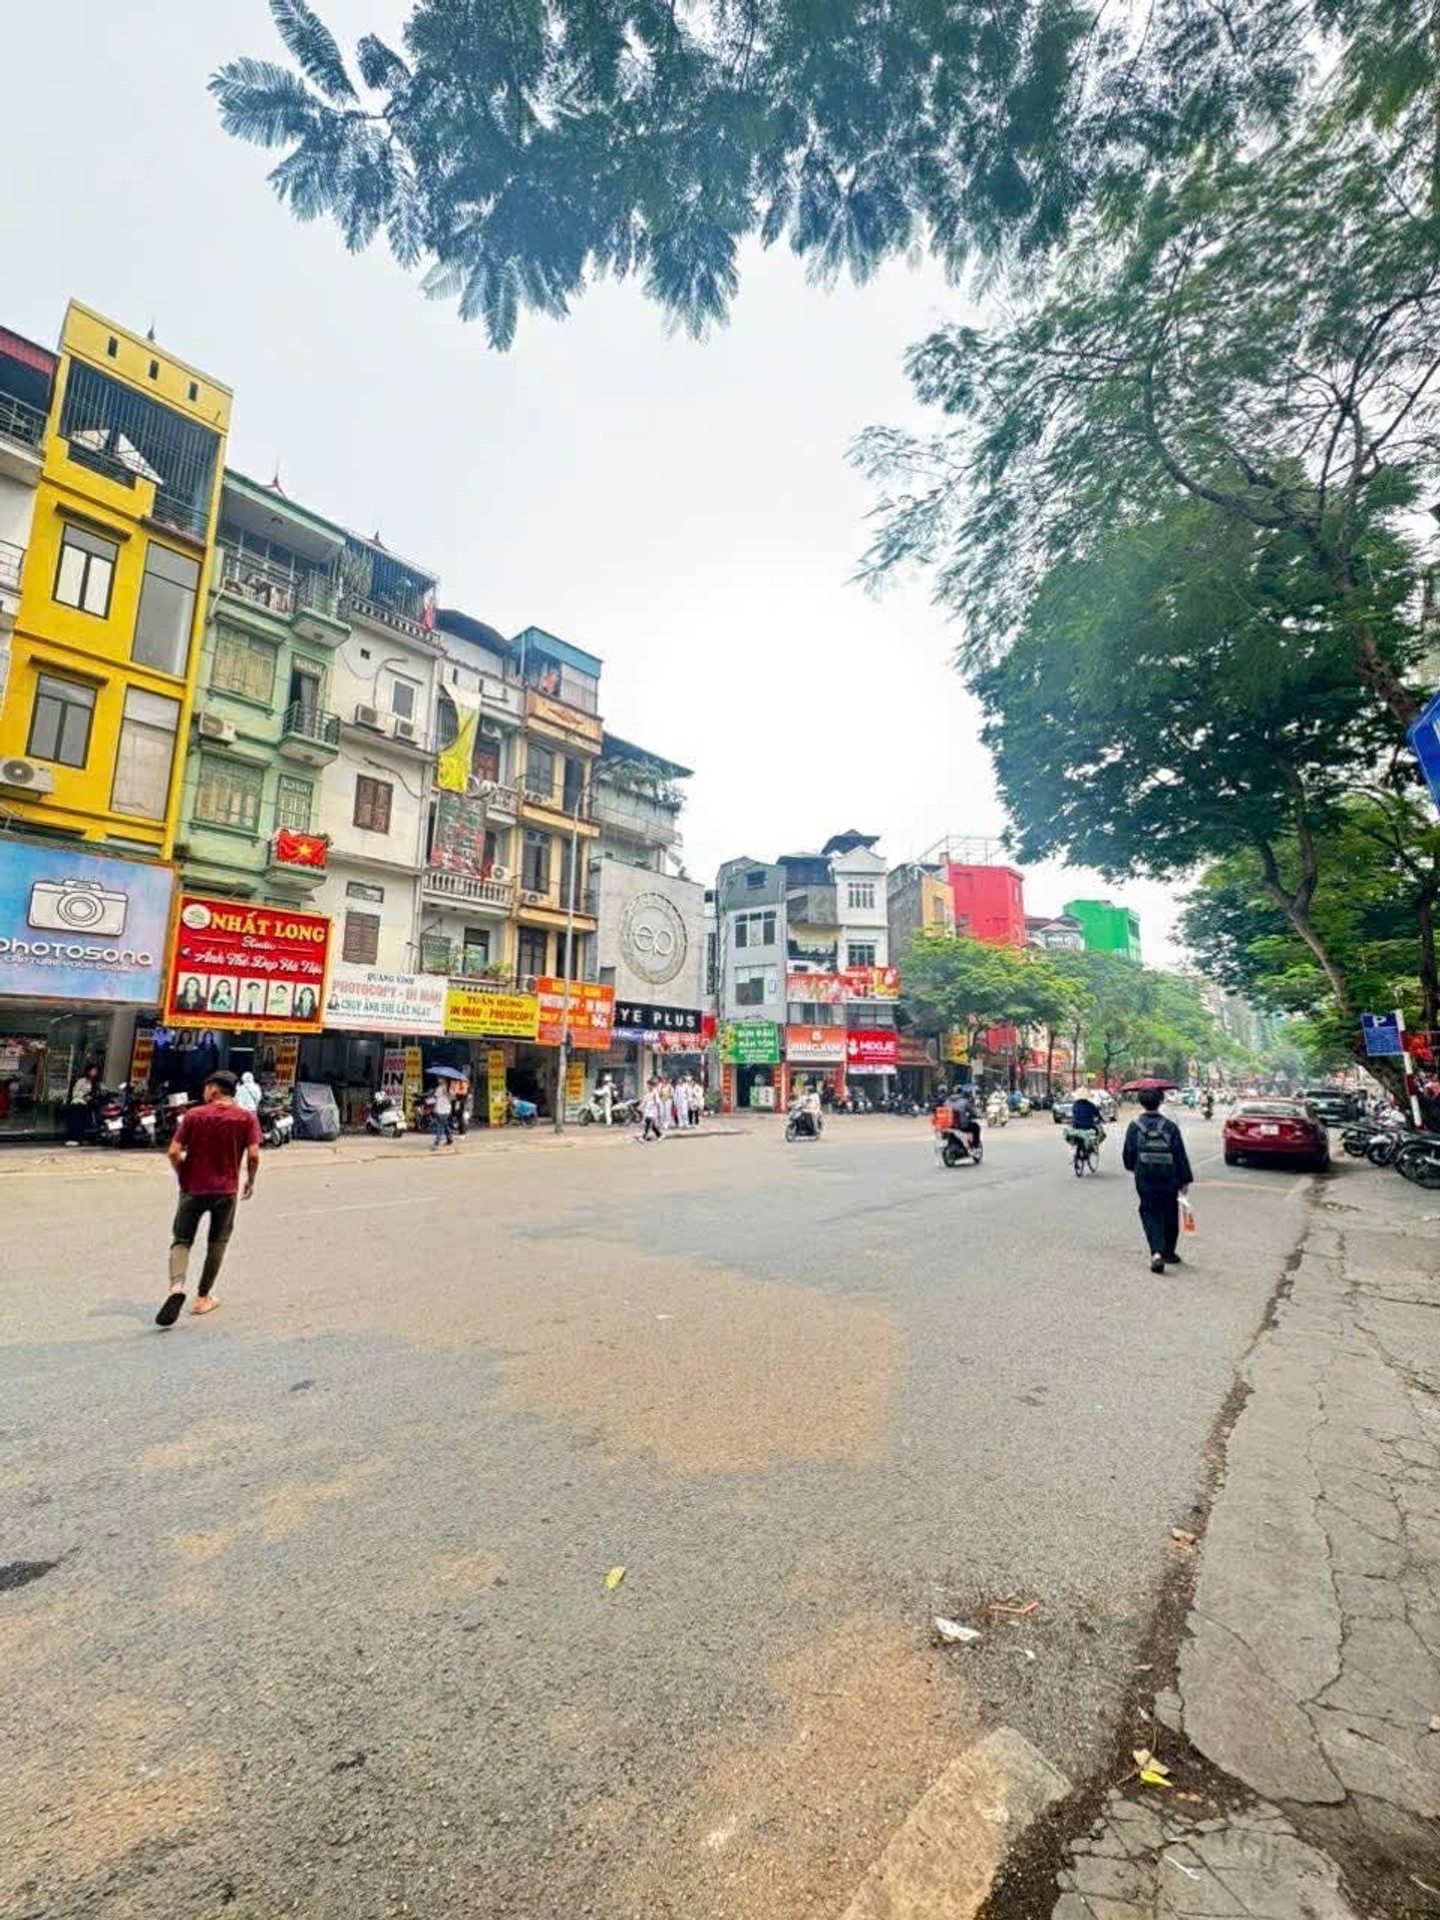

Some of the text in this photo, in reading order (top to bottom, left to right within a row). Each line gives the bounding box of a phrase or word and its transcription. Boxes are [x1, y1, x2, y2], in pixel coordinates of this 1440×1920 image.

[210, 911, 325, 943] NHẤT LONG
[332, 980, 396, 999] PHOTOCOPY
[653, 1011, 695, 1028] PLUS
[1372, 1015, 1387, 1028] P
